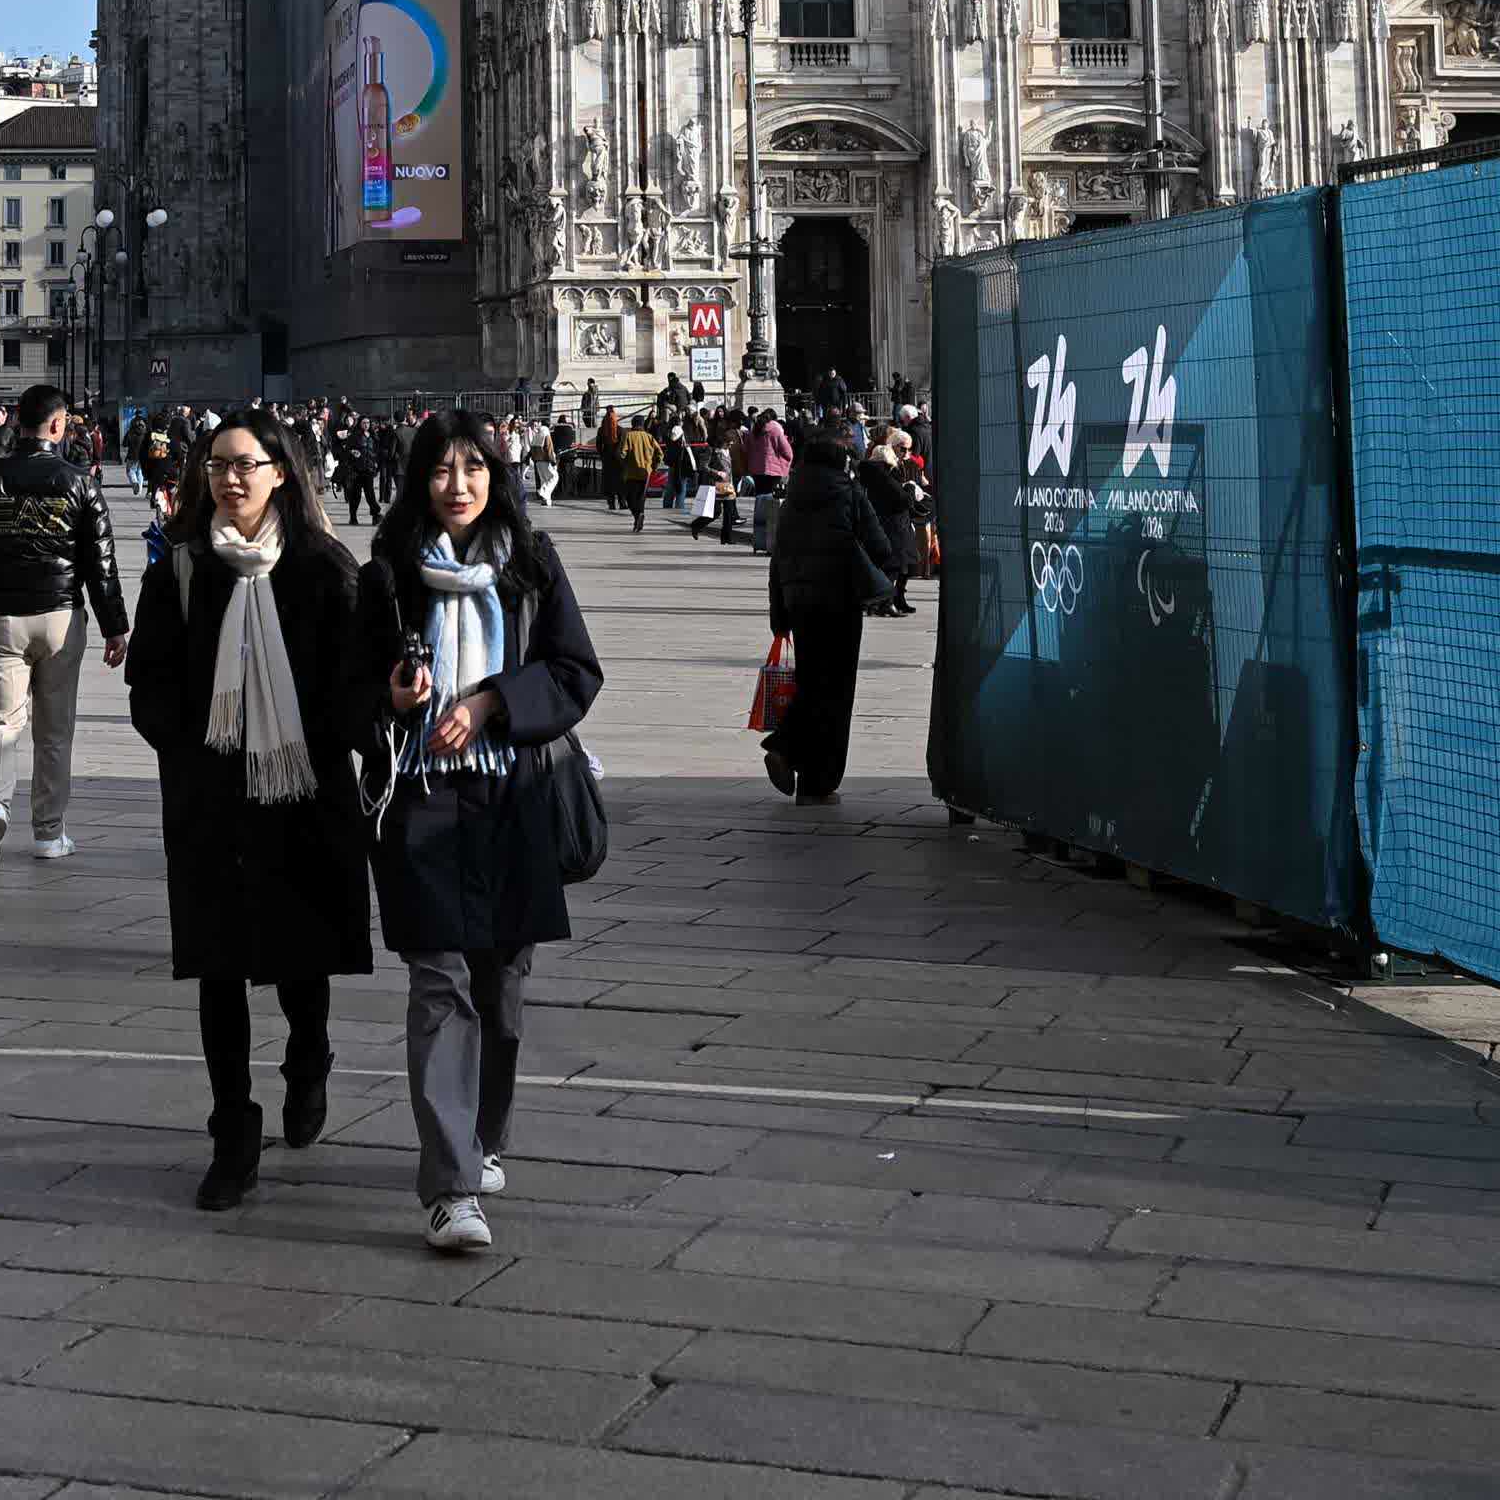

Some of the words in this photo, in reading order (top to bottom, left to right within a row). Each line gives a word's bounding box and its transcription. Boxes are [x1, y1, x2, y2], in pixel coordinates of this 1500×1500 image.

[395, 165, 446, 178] NUOVO
[692, 308, 721, 331] M
[152, 361, 167, 373] M
[1053, 487, 1098, 510] CORTINA
[1105, 488, 1151, 512] MILANO
[1152, 490, 1199, 514] CORTINA
[1043, 511, 1065, 533] 2026
[1141, 516, 1163, 539] 2026
